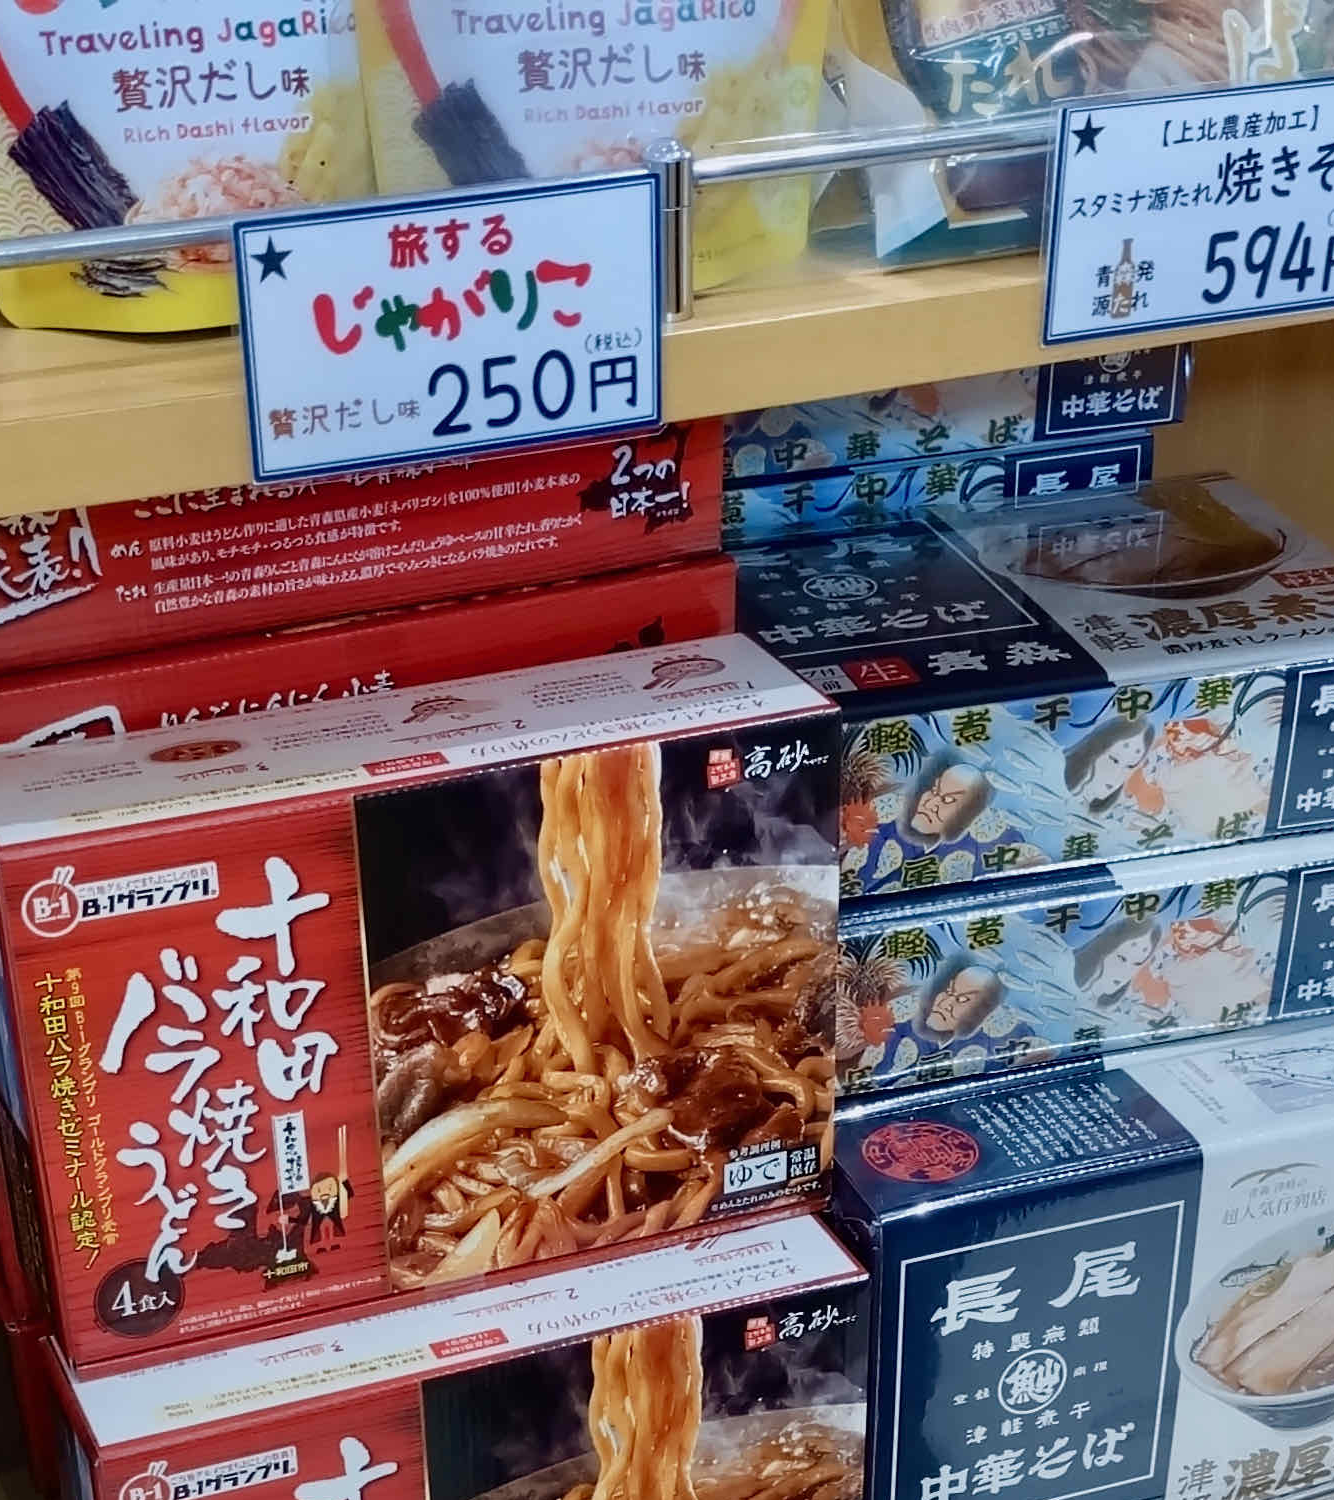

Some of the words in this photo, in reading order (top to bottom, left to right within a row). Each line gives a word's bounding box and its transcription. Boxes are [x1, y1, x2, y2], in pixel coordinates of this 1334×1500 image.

[39, 25, 205, 57] Traveling
[452, 6, 606, 36] Traveling
[112, 60, 312, 113] 贅沢だし味
[516, 43, 708, 95] 贅沢だし味
[123, 122, 170, 143] Rich
[175, 118, 235, 140] Dashi
[240, 113, 312, 138] flavor
[523, 105, 568, 124] Rich
[574, 100, 632, 122] Dashi
[636, 97, 704, 117] flavor
[1161, 104, 1320, 149] 【上北農産加工】
[1068, 182, 1216, 221] スタミナ源たれ
[387, 213, 514, 270] 旅する
[312, 259, 594, 357] じゃがりこ
[267, 398, 423, 442] 贅沢だし味
[427, 347, 641, 439] 250円
[1059, 384, 1165, 421] 中華そば
[609, 443, 677, 487] 2つの
[758, 599, 990, 645] 中華そば
[859, 660, 912, 685] 生
[743, 739, 811, 780] 高砂
[80, 878, 213, 919] B-1グランプリ
[213, 855, 340, 1101] 十和田
[99, 948, 268, 1230] バラ焼き
[33, 971, 102, 1272] 十和田バラ焼きゼミナール認定!
[728, 1157, 781, 1188] ゆで
[115, 1120, 200, 1283] うどん
[110, 1280, 177, 1317] 4食入
[929, 1240, 1142, 1337] 長尾
[779, 1305, 837, 1342] 高砂
